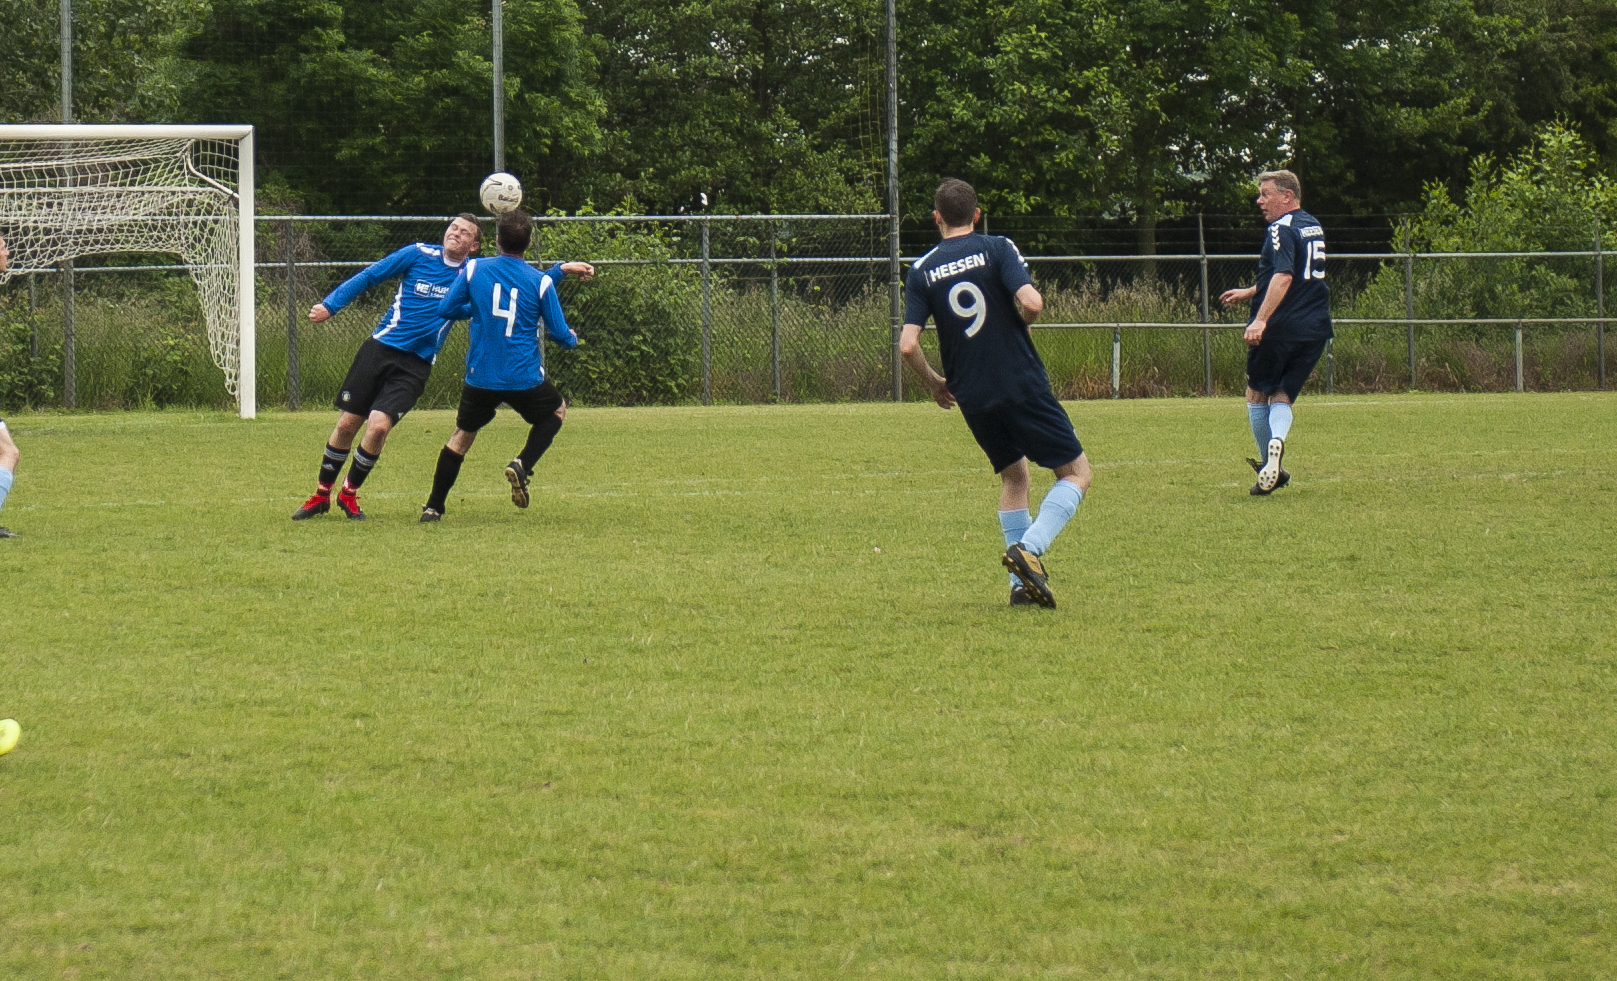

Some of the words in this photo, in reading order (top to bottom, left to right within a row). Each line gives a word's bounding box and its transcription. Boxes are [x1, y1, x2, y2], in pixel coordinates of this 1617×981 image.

[929, 253, 986, 283] HEESEN
[492, 282, 519, 338] 4
[949, 281, 987, 338] 9
